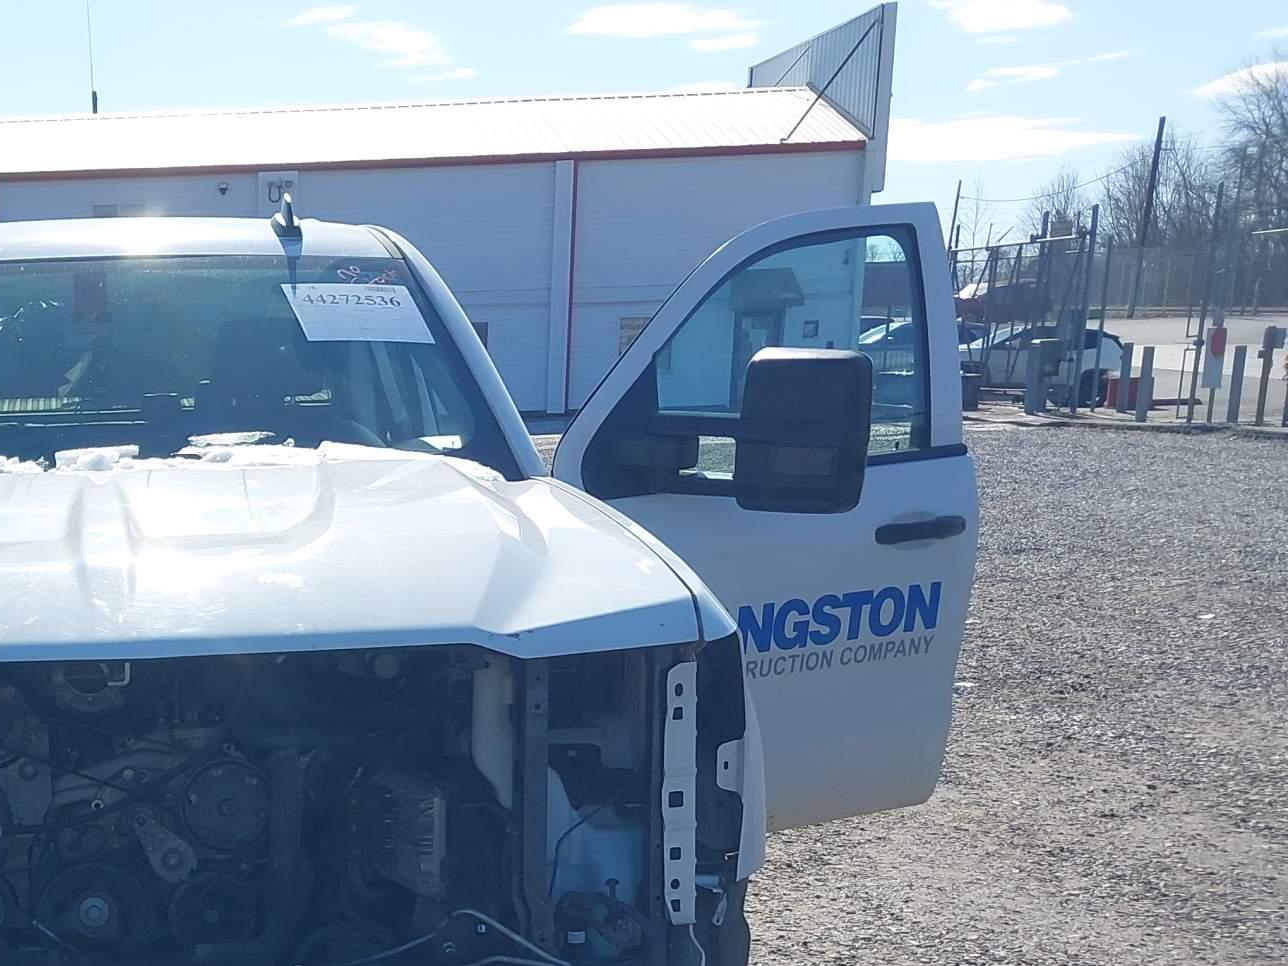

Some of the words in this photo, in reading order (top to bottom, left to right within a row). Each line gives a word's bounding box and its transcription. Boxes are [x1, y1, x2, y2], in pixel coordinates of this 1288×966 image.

[302, 294, 401, 308] 44272536
[738, 581, 942, 653] NGSTON
[745, 648, 834, 679] RUCTION
[839, 634, 935, 665] COMPANY
